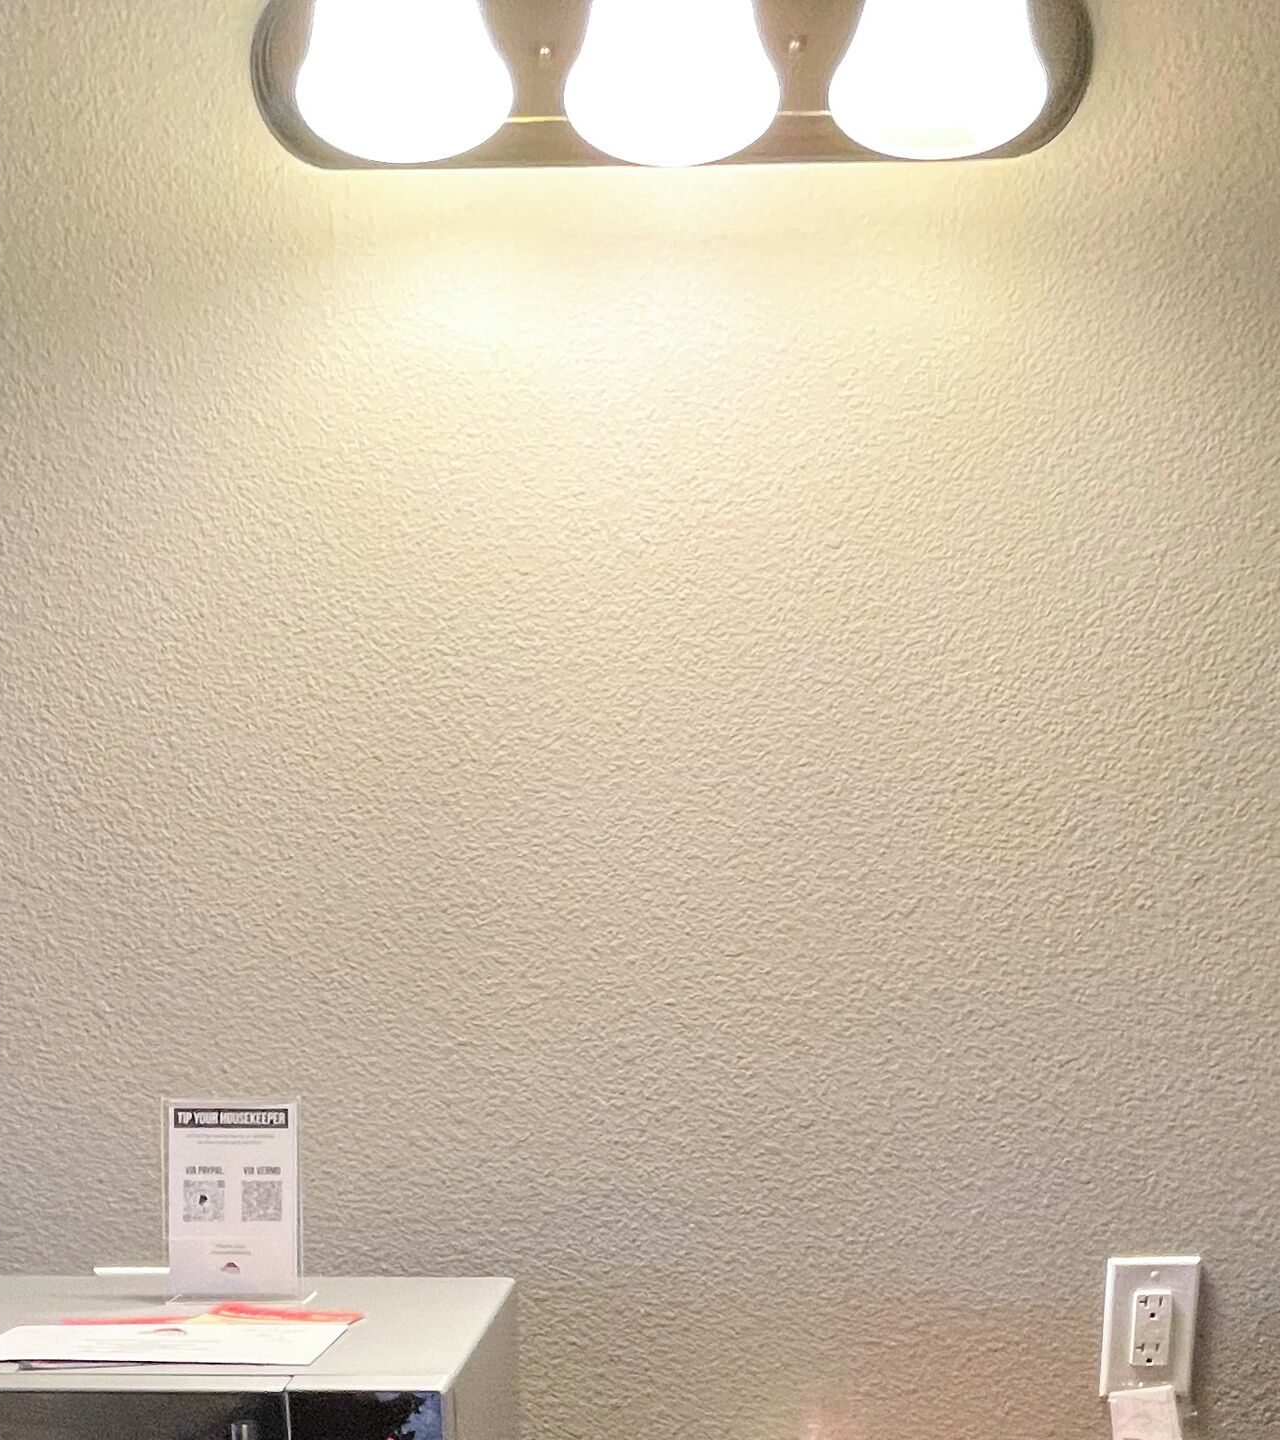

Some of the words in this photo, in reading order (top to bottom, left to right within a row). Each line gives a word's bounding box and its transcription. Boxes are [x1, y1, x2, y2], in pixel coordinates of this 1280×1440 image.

[178, 1112, 192, 1124] TIP
[194, 1111, 219, 1124] YOUR
[220, 1111, 286, 1125] HOUSEKEEPER
